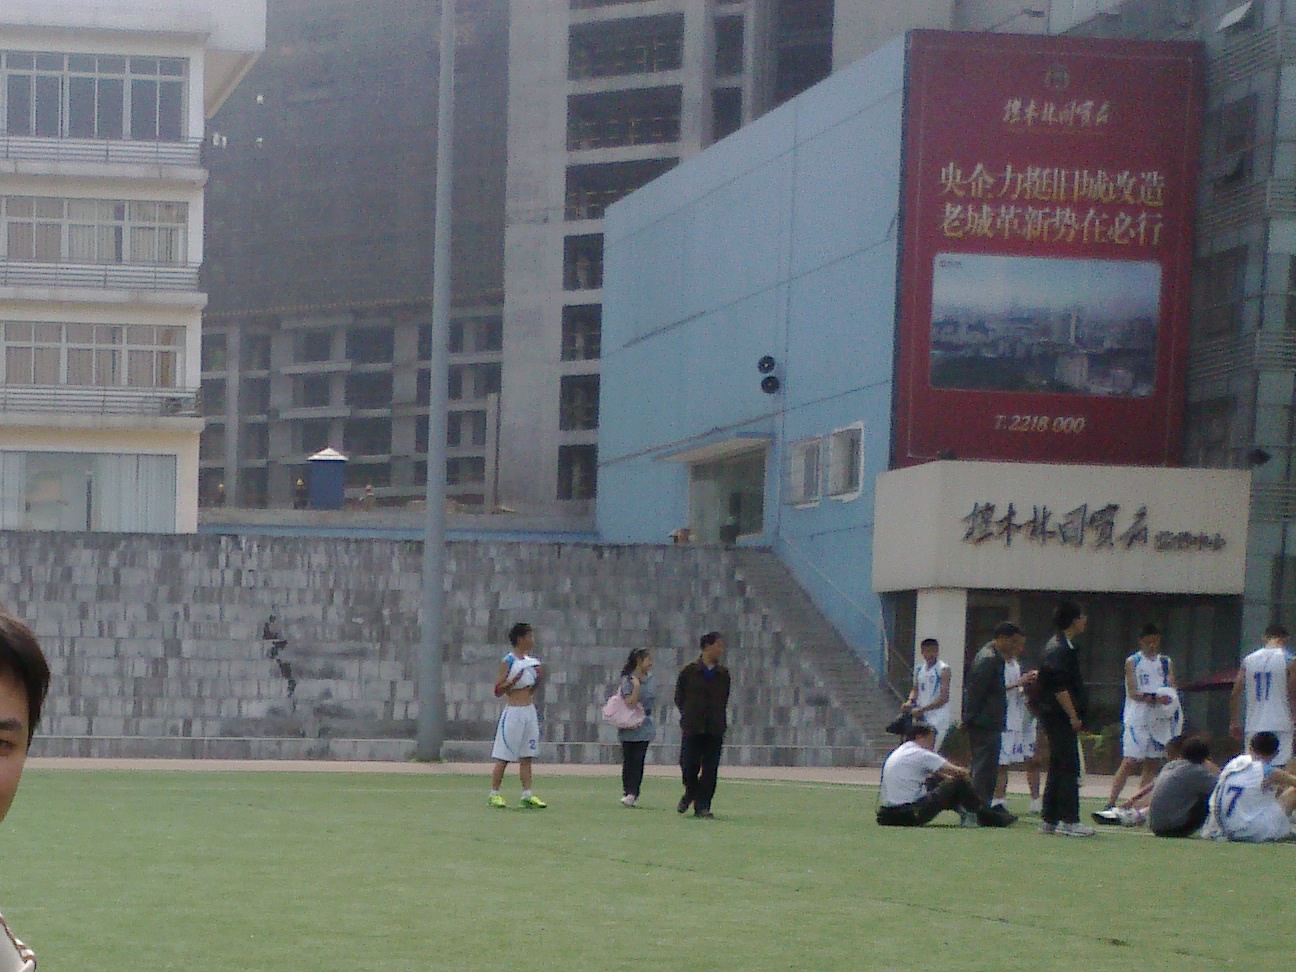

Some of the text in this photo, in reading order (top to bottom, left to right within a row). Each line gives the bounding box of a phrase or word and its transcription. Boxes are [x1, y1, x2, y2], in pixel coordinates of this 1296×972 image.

[939, 161, 1165, 207] 央企力挺旧城改造
[942, 202, 1164, 246] 老城革新势在必行
[1254, 671, 1273, 701] 11
[1226, 786, 1245, 819] 7
